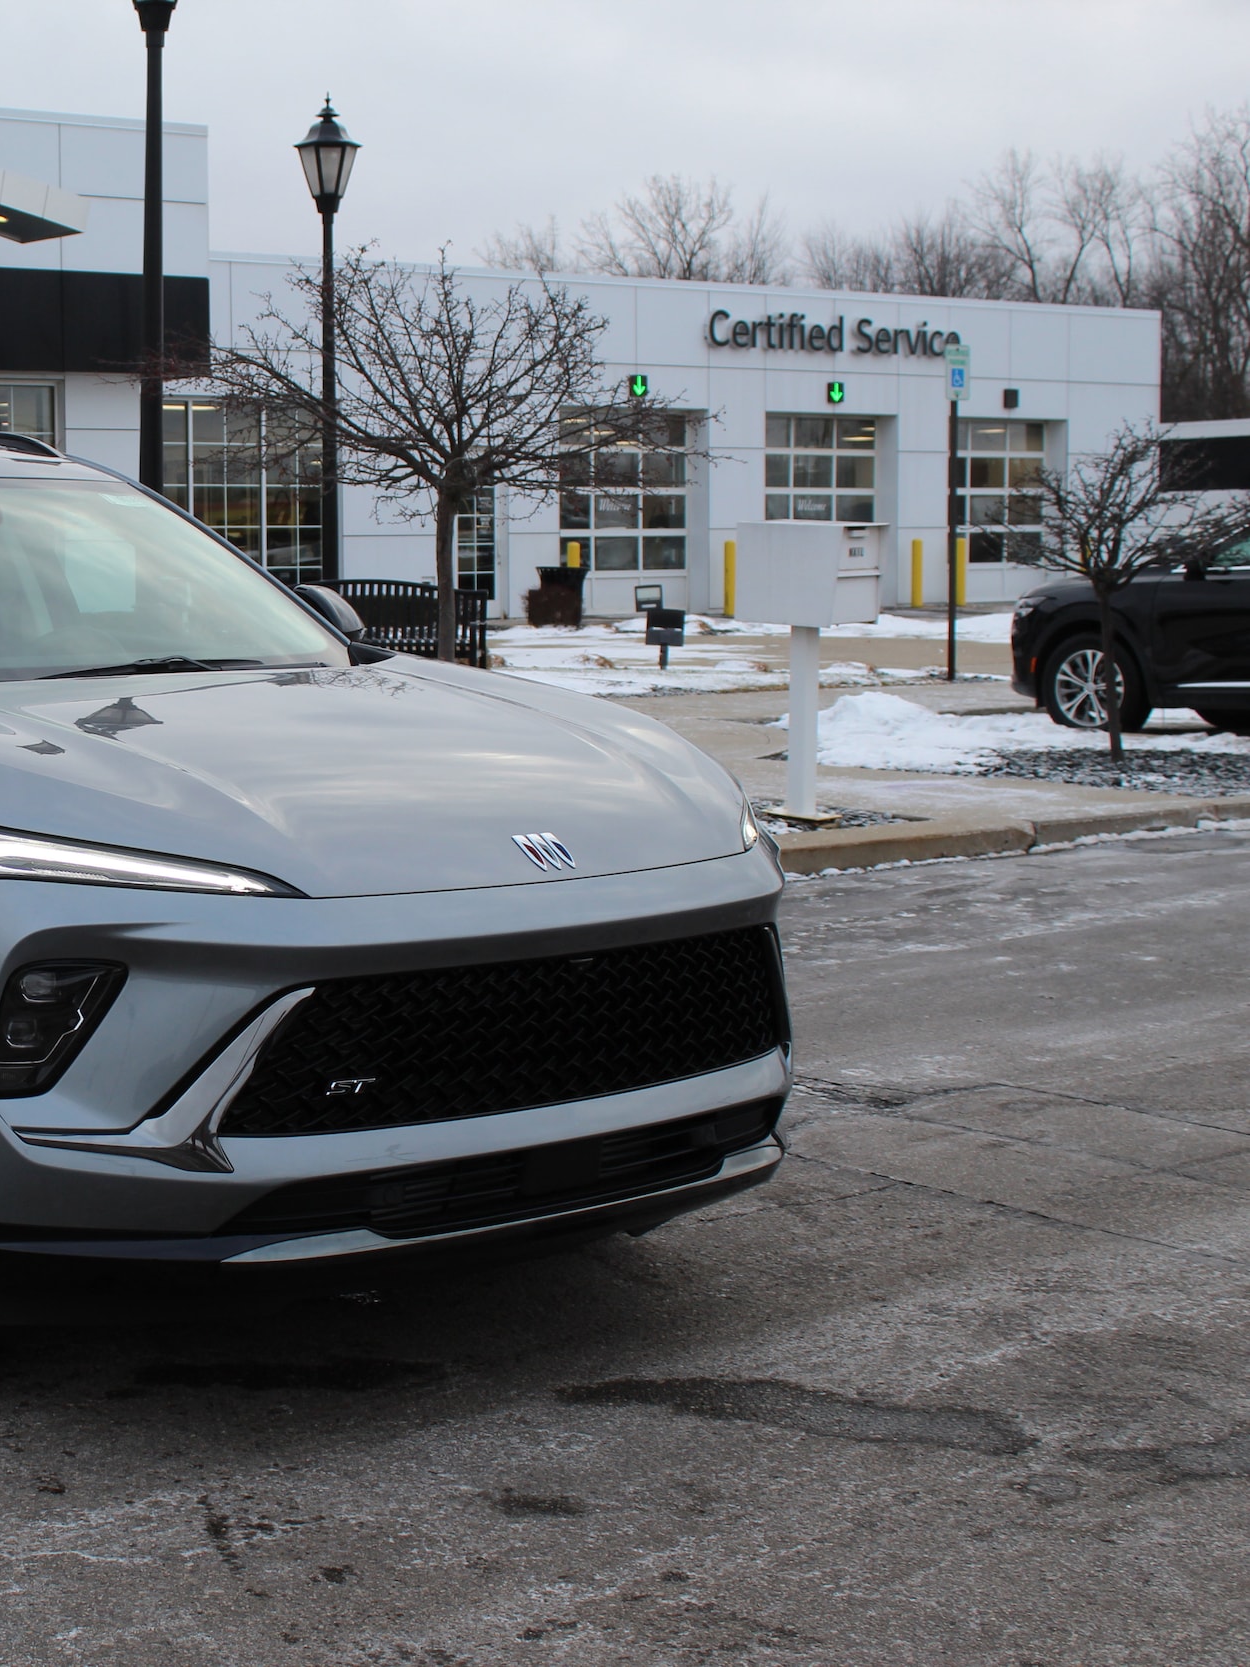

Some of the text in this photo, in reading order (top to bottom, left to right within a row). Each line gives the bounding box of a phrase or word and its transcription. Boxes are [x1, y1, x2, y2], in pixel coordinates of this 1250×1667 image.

[709, 309, 961, 357] Certified Service
[797, 499, 827, 511] Welcome
[325, 1077, 376, 1096] ST
